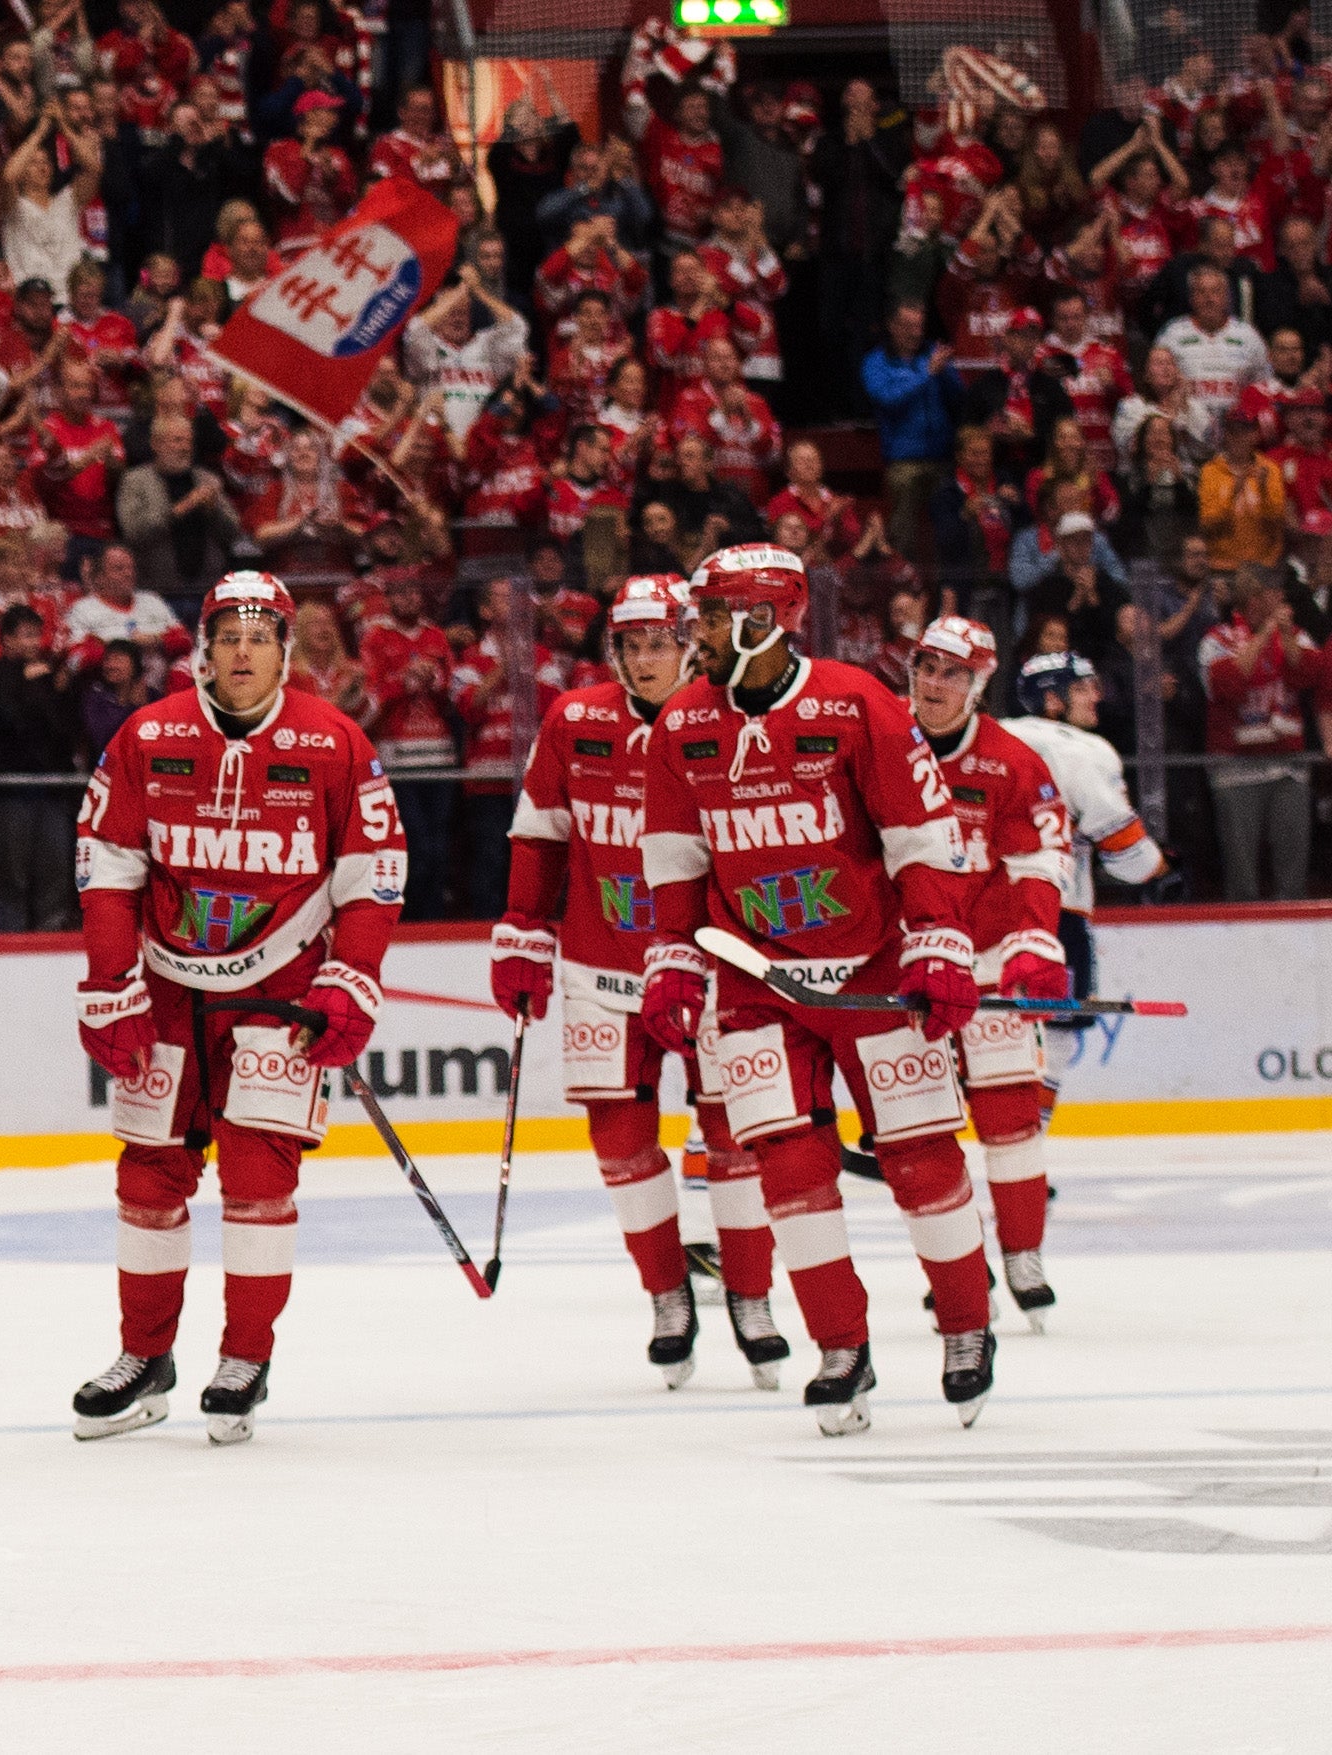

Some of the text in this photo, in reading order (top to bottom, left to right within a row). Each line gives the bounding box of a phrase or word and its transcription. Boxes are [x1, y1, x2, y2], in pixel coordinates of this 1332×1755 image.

[586, 705, 619, 722] SCA
[686, 708, 721, 725] SCA
[821, 699, 861, 718] SCA
[162, 723, 201, 739] SCA
[298, 732, 336, 750] SCA
[731, 780, 793, 800] stadium
[195, 802, 262, 822] stadium
[570, 798, 646, 849] TIM
[147, 815, 320, 876] TIMRÅ
[596, 872, 657, 933] NH
[733, 864, 852, 940] NHK
[238, 1054, 309, 1081] LBM
[874, 1054, 944, 1083] LBM
